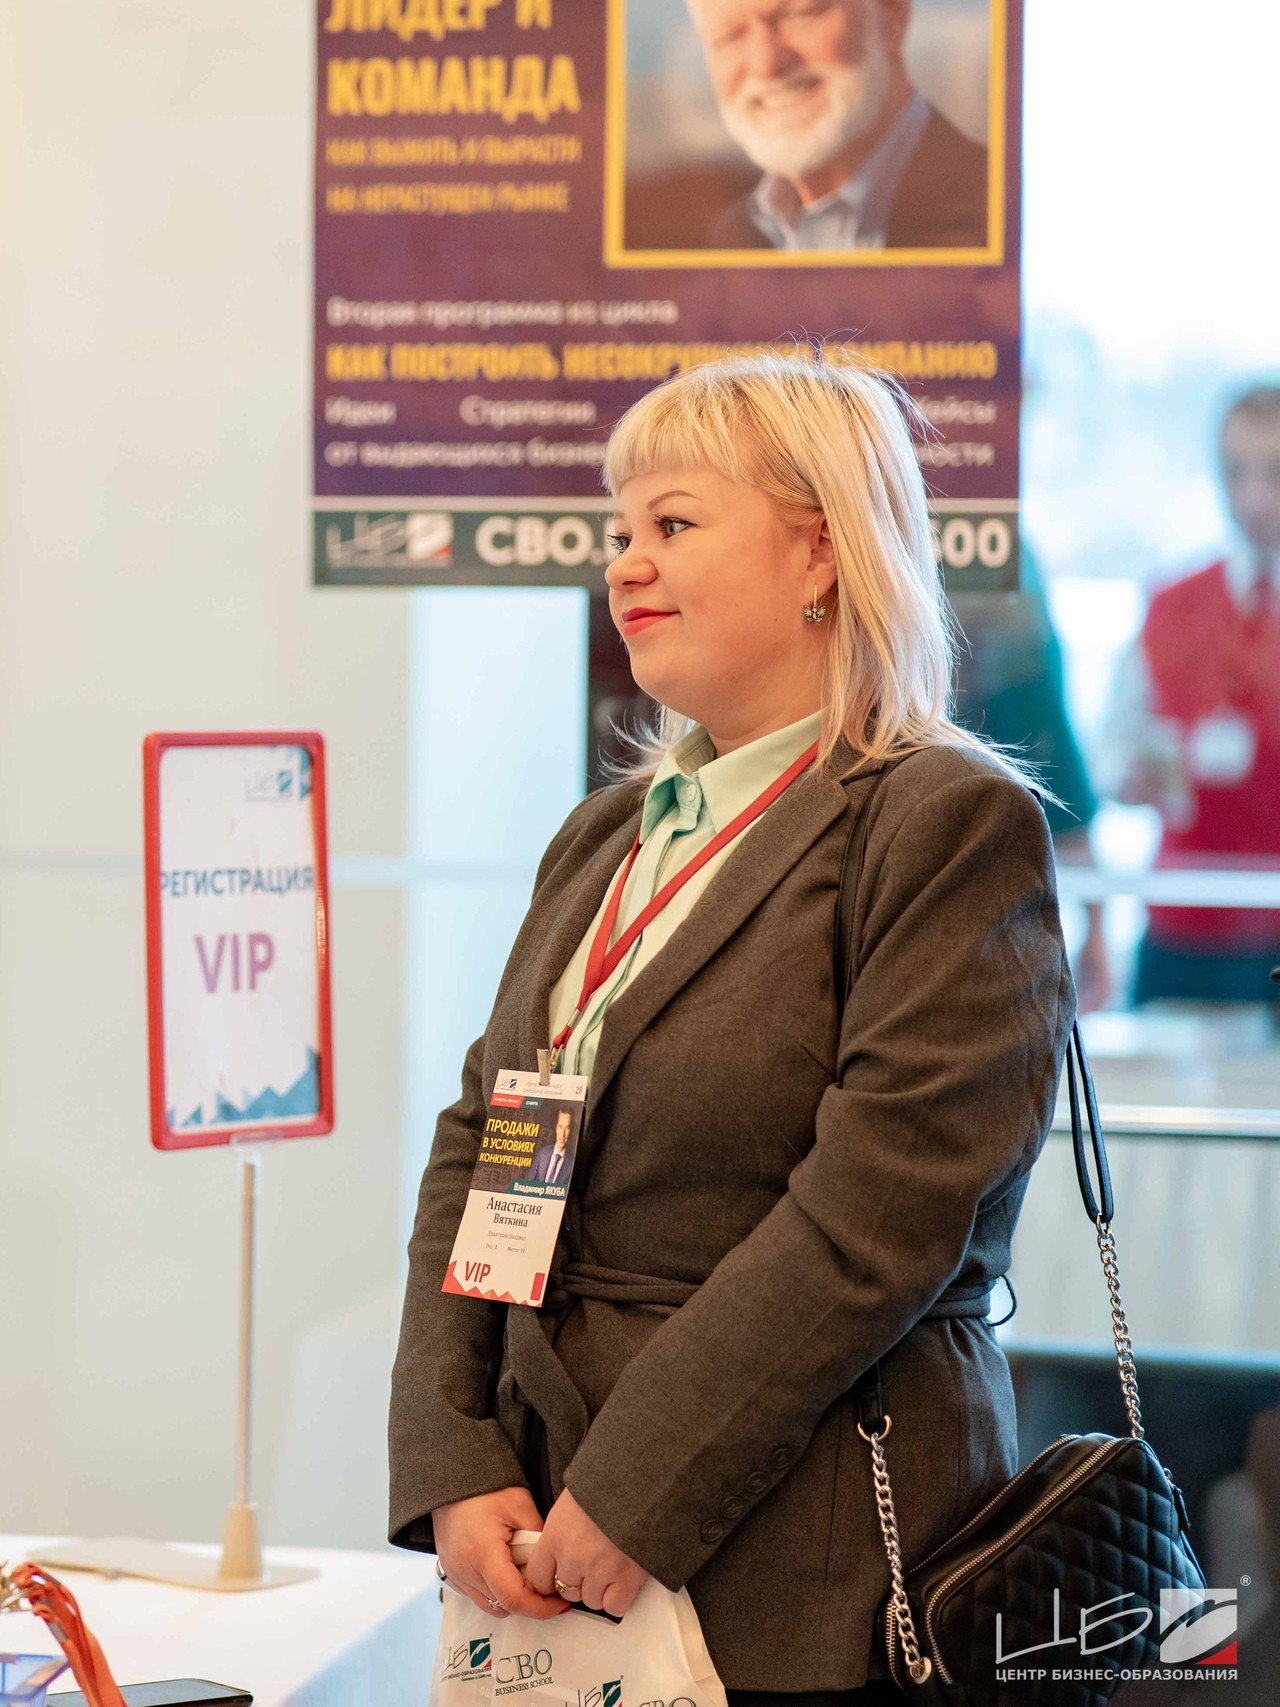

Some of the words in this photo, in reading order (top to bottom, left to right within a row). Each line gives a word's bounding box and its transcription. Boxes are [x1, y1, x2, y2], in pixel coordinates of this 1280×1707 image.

[324, 0, 503, 42] ЛИДЕР
[514, 0, 554, 30] И
[327, 54, 582, 124] КОМАНДА
[327, 297, 417, 331] Вторая
[421, 299, 565, 331] программа
[600, 299, 679, 328] цикла
[327, 342, 387, 382] КАК
[389, 342, 560, 382] ПОСТРОИТЬ
[325, 395, 397, 427] Идеи
[459, 394, 597, 430] Стратегии
[324, 441, 359, 468] от
[361, 441, 522, 468] выдающихся
[160, 864, 314, 898] РЕГИСТРАЦИЯ
[194, 931, 276, 994] VIP
[485, 1118, 540, 1137] ПРОДАЖИ
[482, 1137, 489, 1148] В
[489, 1138, 535, 1153] УСЛОВИЯХ
[479, 1152, 532, 1167] КОНКУРЕНЦИИ
[513, 1182, 545, 1197] Владимир
[544, 1185, 565, 1197] ЯКУБА
[486, 1196, 542, 1216] Анастасия
[493, 1213, 528, 1228] Вяткина
[465, 1260, 491, 1283] VIP
[495, 1648, 553, 1684] CBO
[495, 1682, 529, 1697] BUSINESS
[529, 1676, 554, 1690] SCHOOL
